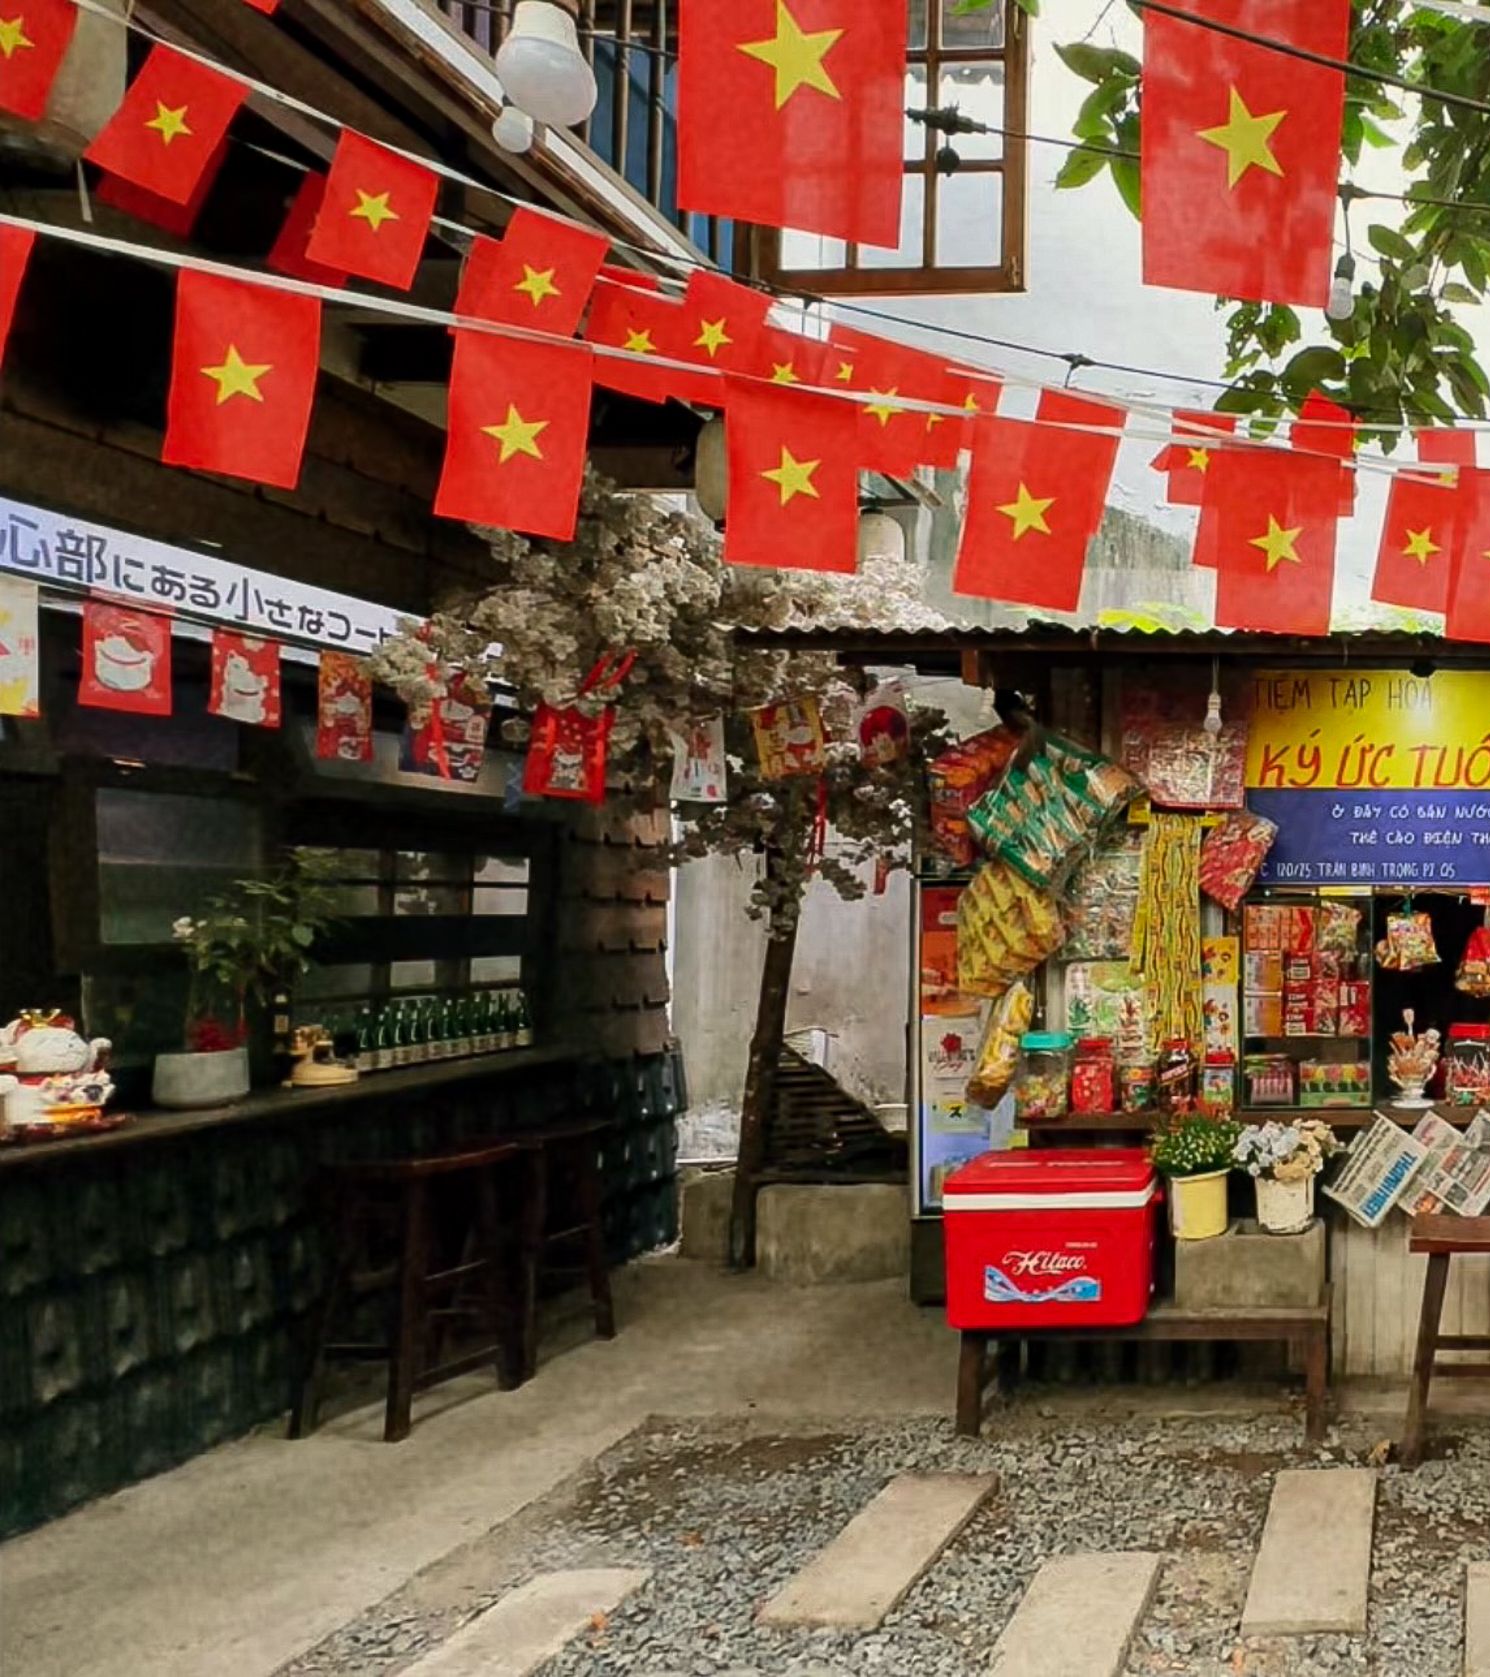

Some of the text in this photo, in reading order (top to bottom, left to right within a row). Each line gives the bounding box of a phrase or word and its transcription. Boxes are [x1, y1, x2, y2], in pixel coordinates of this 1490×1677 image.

[1258, 728, 1321, 787] KÝ
[1335, 733, 1395, 787] ỨC
[1389, 803, 1409, 818] CÓ
